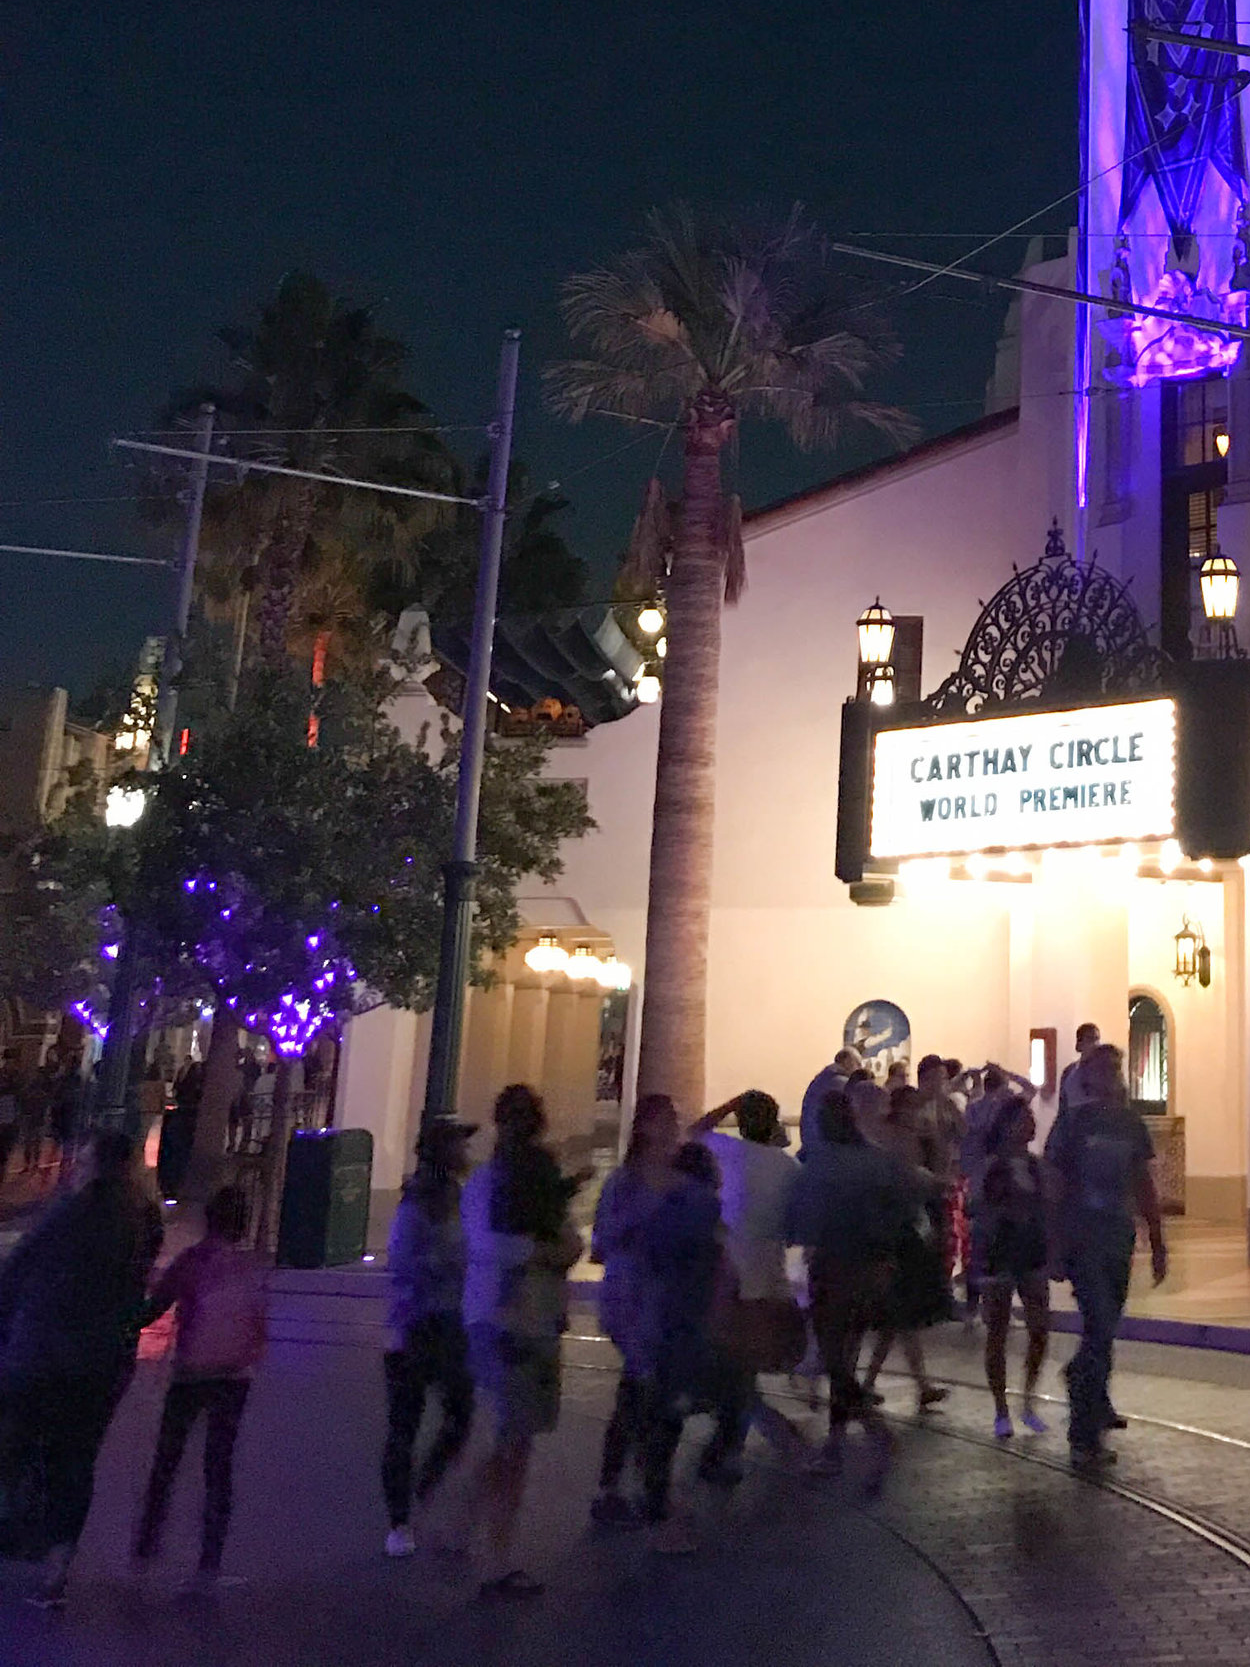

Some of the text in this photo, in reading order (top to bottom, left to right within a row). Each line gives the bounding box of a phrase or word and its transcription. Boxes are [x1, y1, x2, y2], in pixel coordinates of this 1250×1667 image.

[910, 731, 1144, 783] CARTHAY CIRCLE
[919, 779, 1132, 822] WORLD PREMIERE
